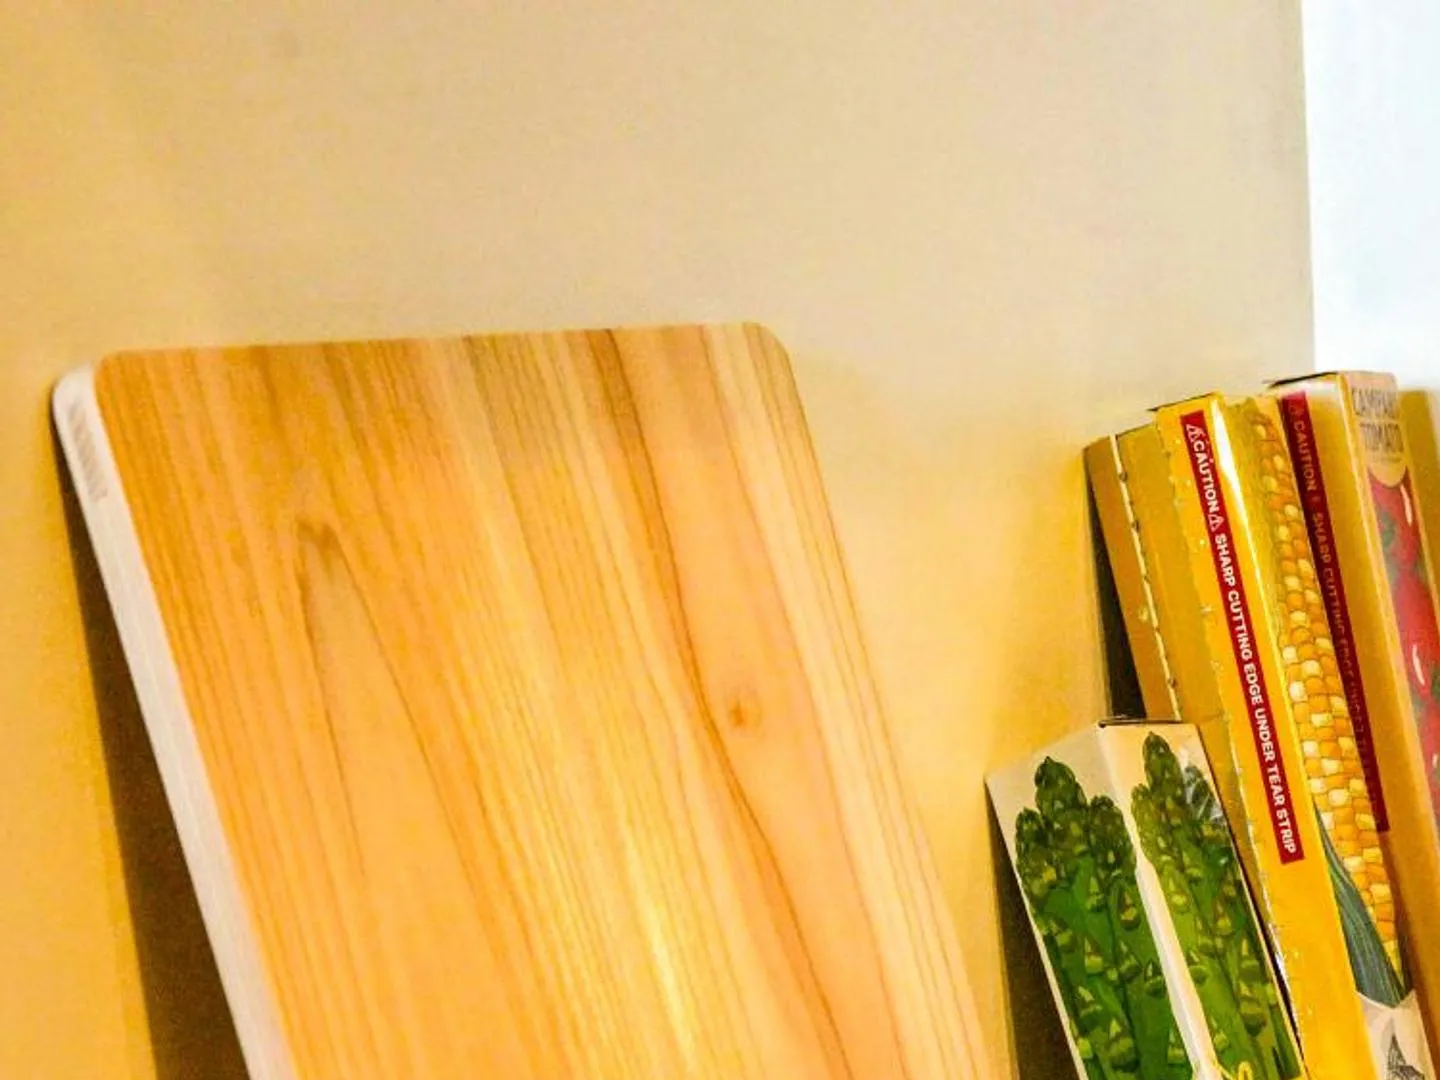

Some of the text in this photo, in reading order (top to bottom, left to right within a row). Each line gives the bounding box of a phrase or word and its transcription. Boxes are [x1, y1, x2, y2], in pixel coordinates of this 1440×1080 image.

[1192, 439, 1297, 855] CAUTION SHARP CUTTING EDGE UNDER TEAR STRIP
